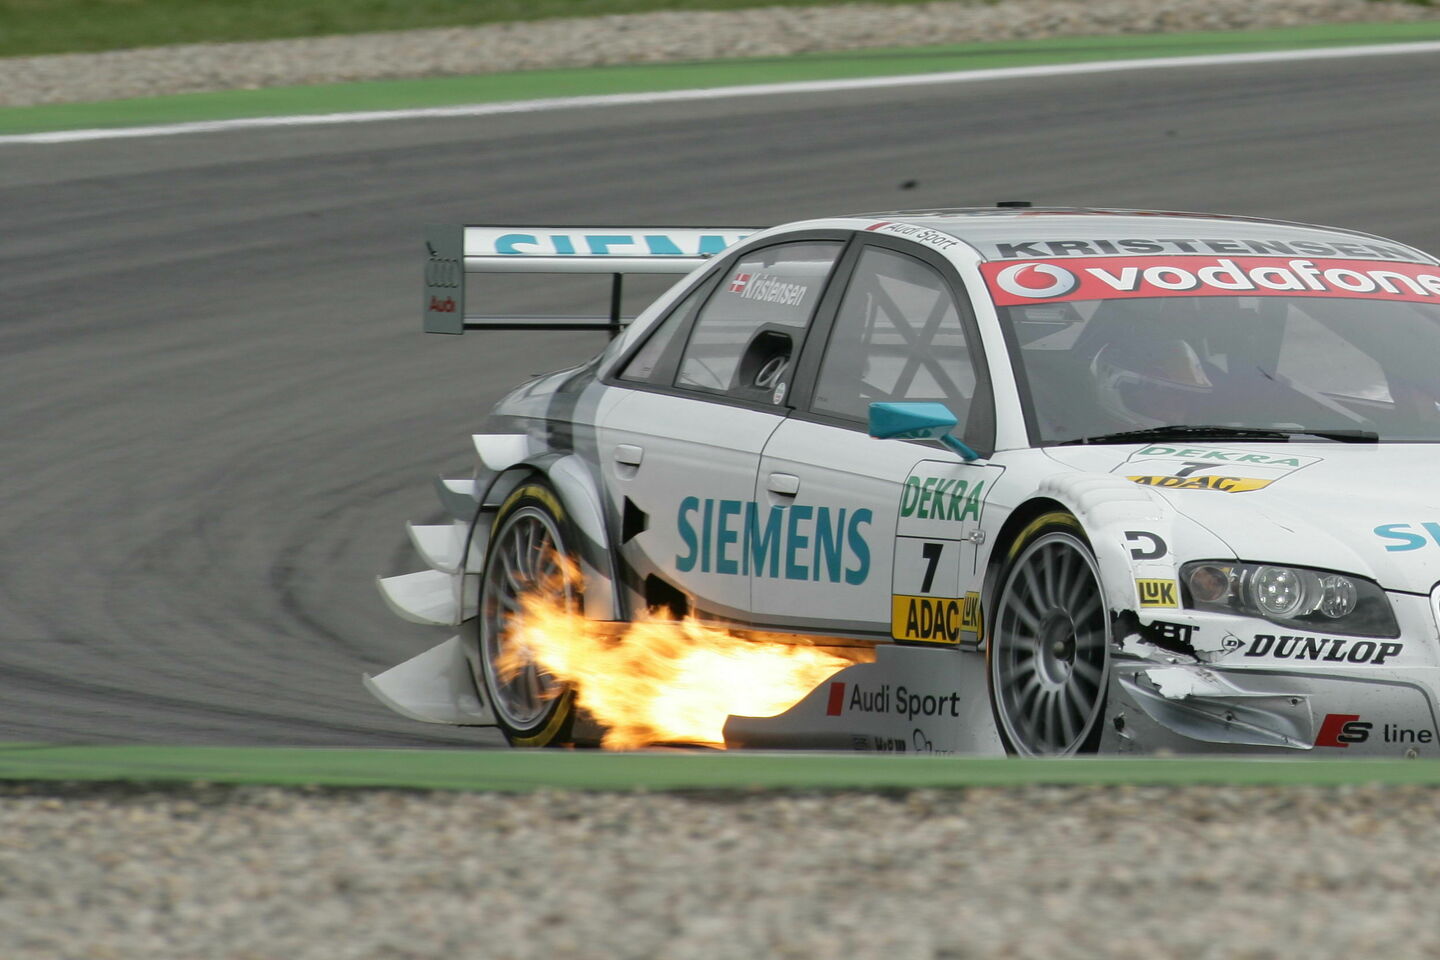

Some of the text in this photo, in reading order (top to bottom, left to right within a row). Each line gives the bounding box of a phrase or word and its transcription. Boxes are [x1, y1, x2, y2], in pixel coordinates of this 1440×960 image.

[886, 223, 960, 250] Audi Sport
[998, 238, 1421, 262] KRISTENSEN
[740, 273, 807, 307] Kristensen
[1138, 446, 1299, 467] DEKRA
[1174, 461, 1223, 477] 7
[901, 475, 985, 521] DEKRA
[1134, 475, 1241, 491] ADAC
[675, 496, 873, 586] SIEMENS
[921, 542, 944, 593] 7
[906, 598, 960, 642] ADAC
[1245, 634, 1403, 664] DUNLOP
[850, 684, 960, 721] Audi Sport
[1337, 722, 1432, 743] S line
